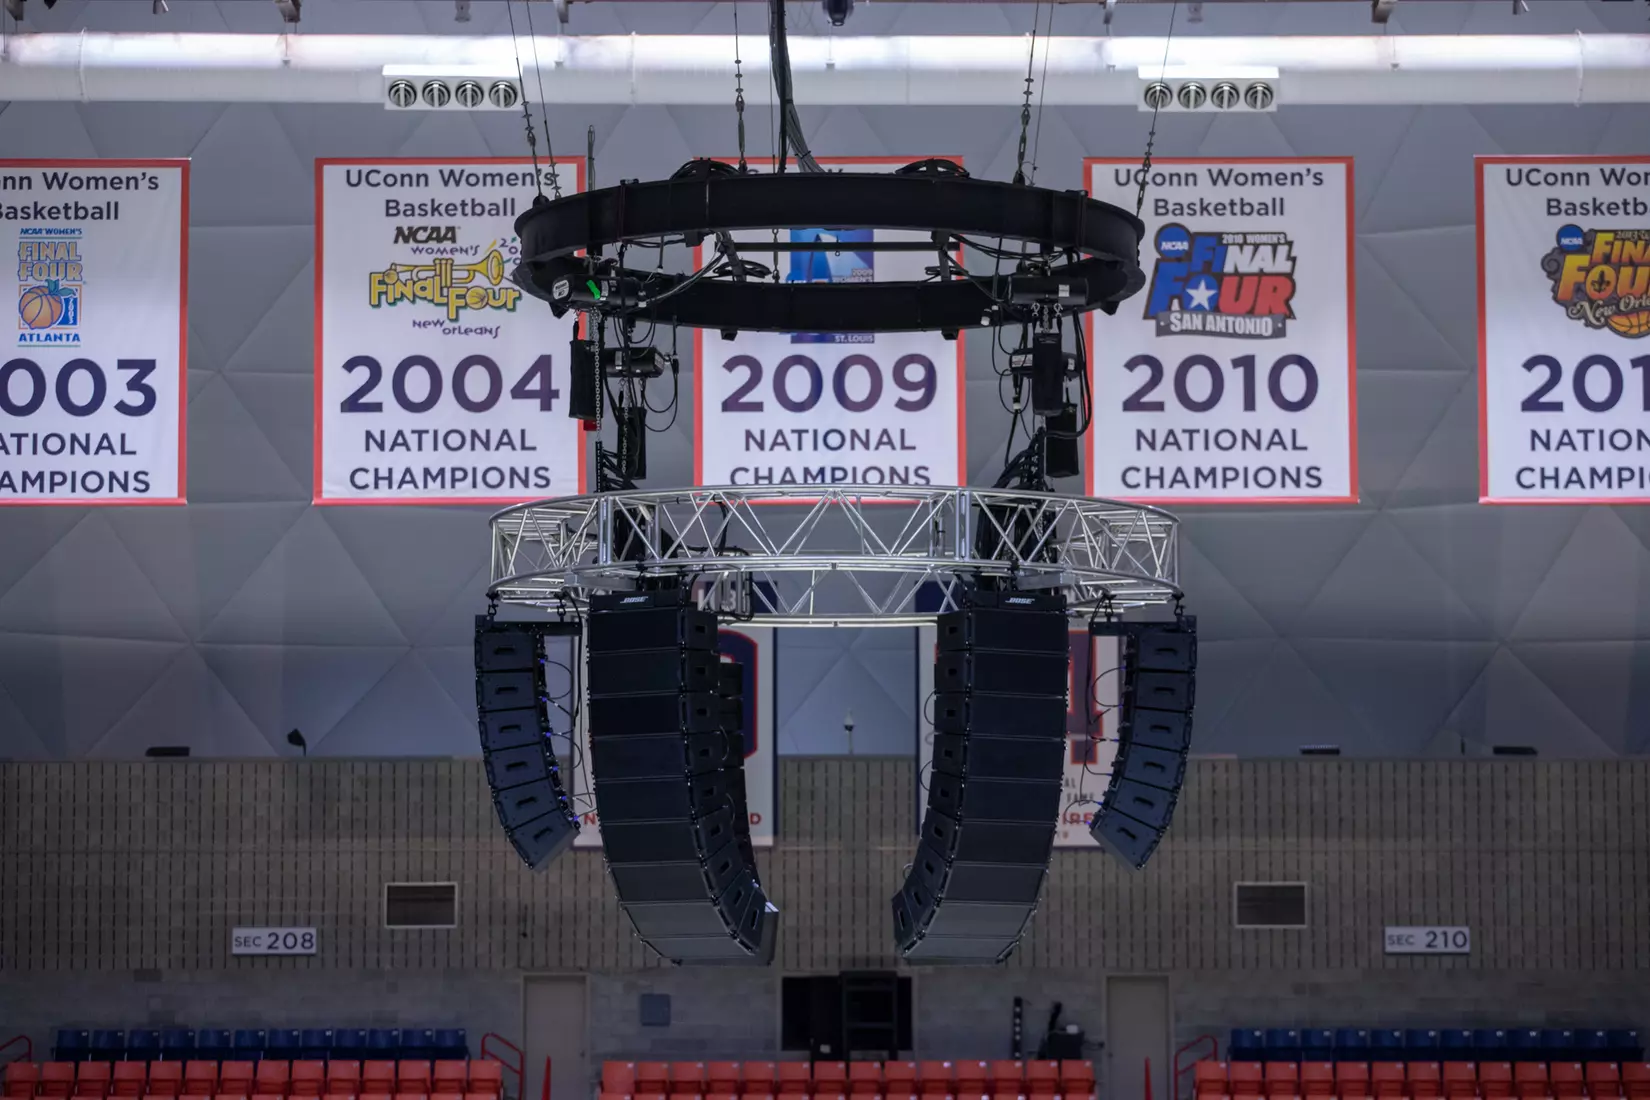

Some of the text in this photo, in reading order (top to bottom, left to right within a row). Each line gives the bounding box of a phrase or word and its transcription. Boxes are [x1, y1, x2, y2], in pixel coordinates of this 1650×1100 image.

[42, 172, 160, 191] Women's
[346, 168, 555, 188] UConn Women's
[1114, 167, 1324, 187] UConn Women's
[1506, 168, 1590, 187] UConn
[0, 201, 119, 221] asketball
[385, 198, 515, 218] Basketball
[1153, 197, 1285, 217] Basketball
[1546, 197, 1650, 217] Basketb
[20, 228, 82, 236] NCAA WOMEN'S
[394, 226, 457, 244] NCAA
[1222, 234, 1286, 244] 2010 WOMEN'S
[18, 241, 82, 262] FINAL
[1161, 241, 1189, 251] NCAA
[1189, 235, 1294, 274] FINAL
[17, 262, 83, 282] FOUR
[852, 268, 873, 278] 2009
[1148, 262, 1294, 316] FOUR
[1568, 301, 1616, 326] New
[1169, 312, 1273, 337] SAN ANTONIO
[19, 333, 81, 343] ATLANTA
[834, 334, 873, 343] ST. LOUIS
[0, 357, 157, 418] 003
[340, 354, 560, 414] 2004
[721, 353, 938, 413] 2009
[1122, 353, 1319, 413] 2010
[1521, 353, 1650, 413] 201
[365, 429, 537, 452] NATIONAL
[744, 428, 916, 452] NATIONAL
[1136, 428, 1308, 451] NATIONAL
[350, 466, 552, 490] CHAMPIONS
[730, 465, 931, 486] CHAMPIONS
[1121, 466, 1323, 489] CHAMPIONS
[1515, 465, 1650, 490] CHAMPI
[1006, 597, 1035, 605] BOSE
[234, 932, 314, 950] SEC 208
[1387, 930, 1468, 949] SEC 210
